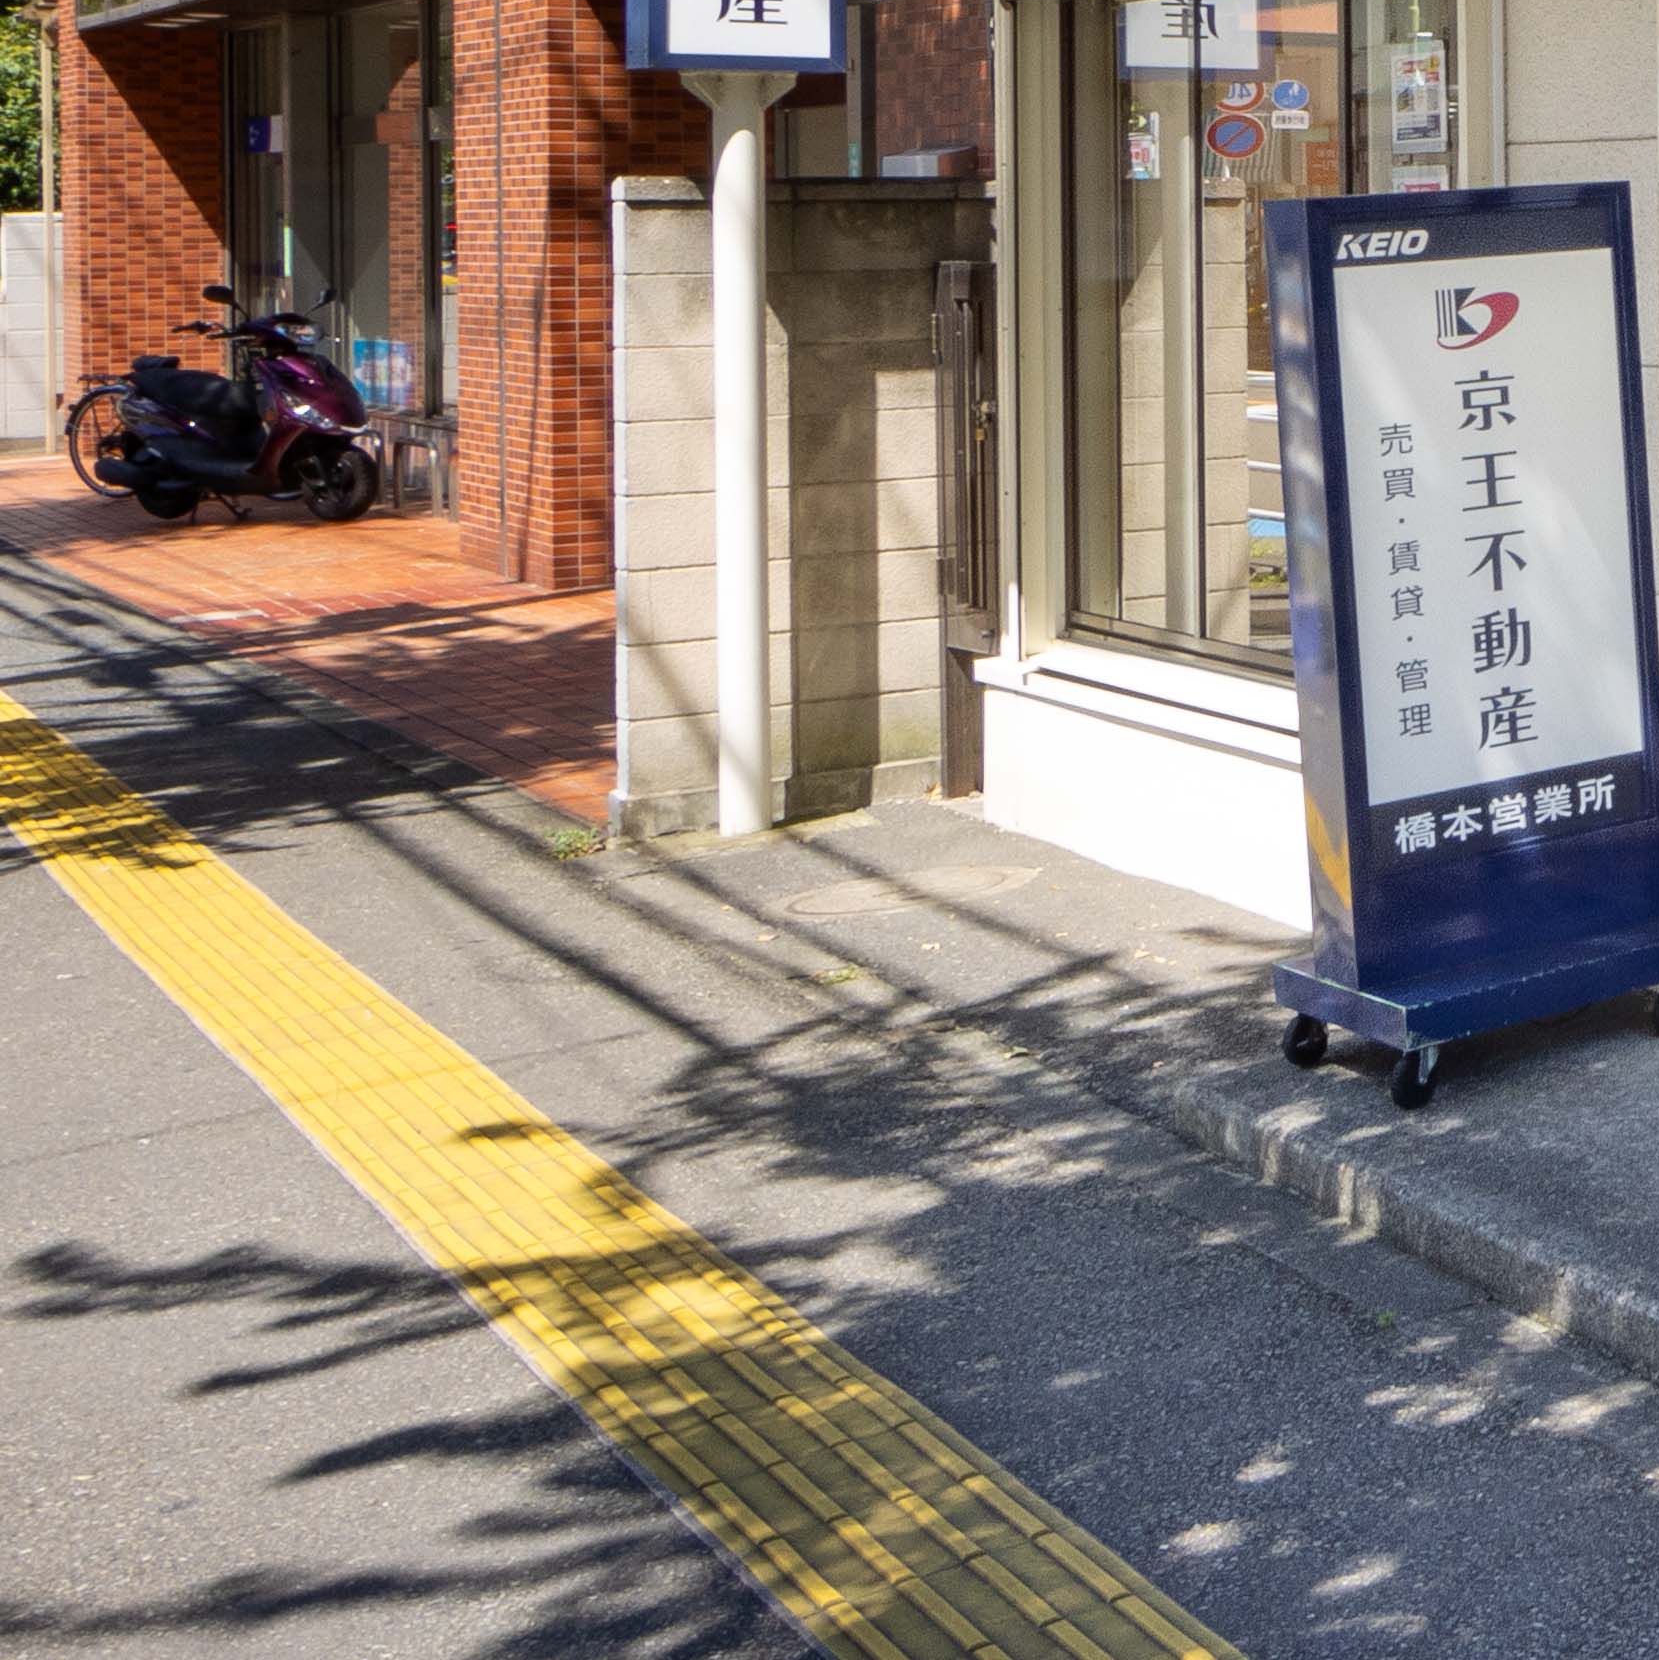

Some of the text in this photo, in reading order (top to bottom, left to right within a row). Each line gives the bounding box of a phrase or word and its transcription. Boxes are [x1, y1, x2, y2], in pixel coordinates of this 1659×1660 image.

[1334, 229, 1430, 261] KEIO
[1378, 423, 1433, 738] 売買・賃貸・管理
[1455, 369, 1539, 751] 京王不動産
[1394, 774, 1616, 854] 橋本営業所
